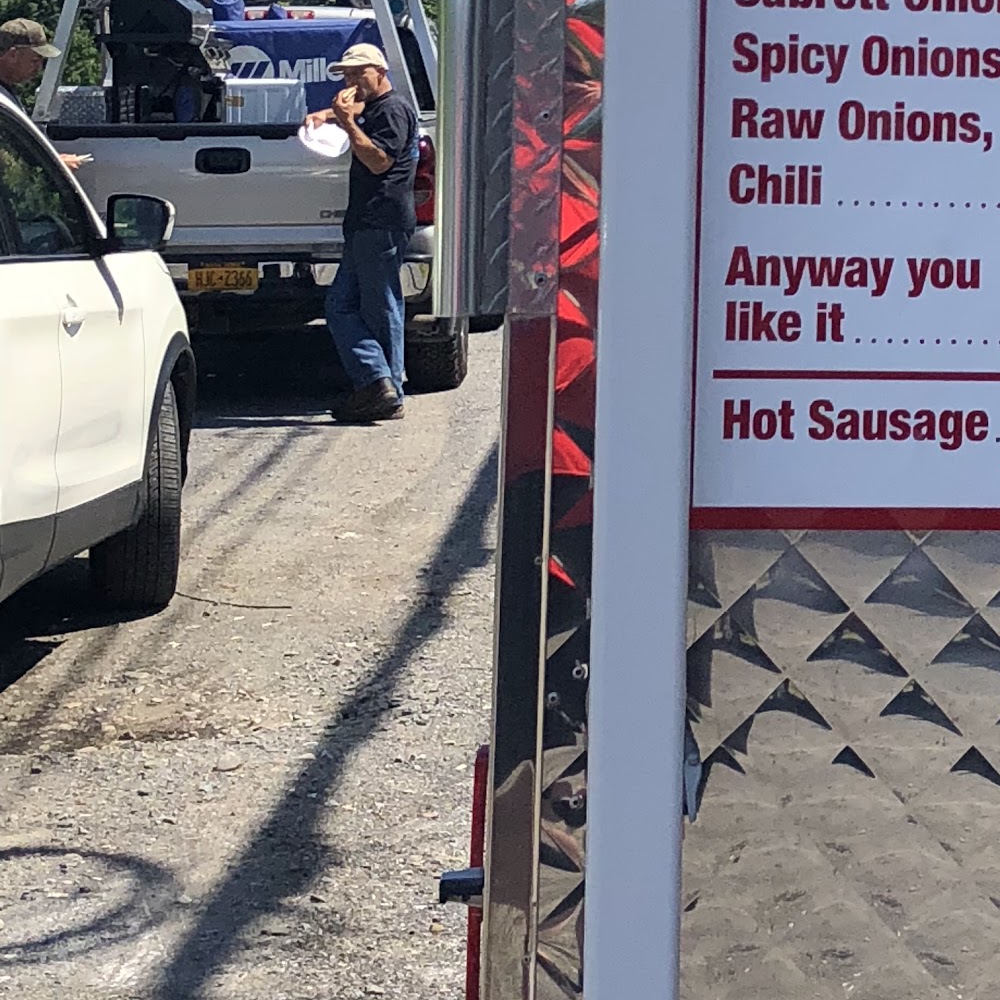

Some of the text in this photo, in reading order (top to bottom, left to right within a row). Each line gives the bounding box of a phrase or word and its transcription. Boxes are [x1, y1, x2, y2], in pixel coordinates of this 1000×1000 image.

[279, 57, 345, 82] Mille
[732, 32, 848, 84] Spicy
[731, 98, 993, 152] Raw Onions,
[728, 163, 822, 206] Chili
[725, 245, 981, 298] Anyway you
[724, 301, 801, 343] like
[815, 302, 845, 343] it
[722, 399, 795, 441] Hot
[808, 399, 989, 451] Sausage
